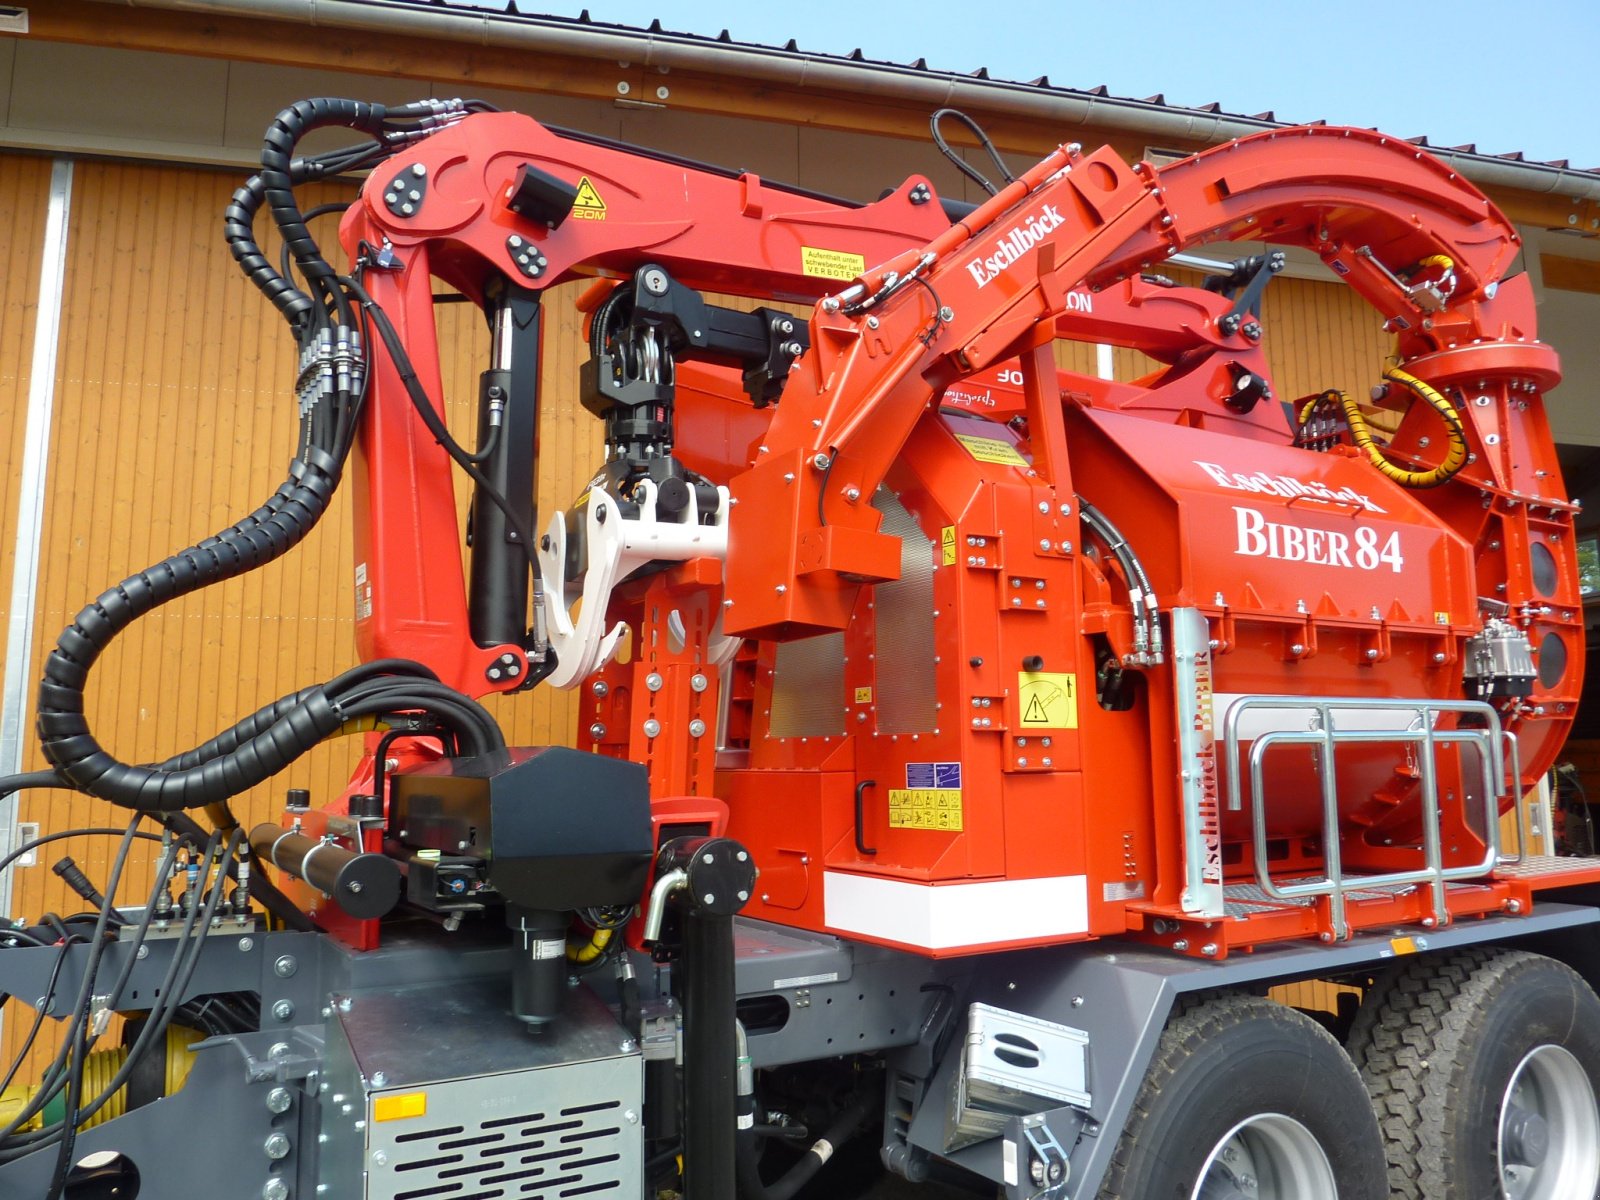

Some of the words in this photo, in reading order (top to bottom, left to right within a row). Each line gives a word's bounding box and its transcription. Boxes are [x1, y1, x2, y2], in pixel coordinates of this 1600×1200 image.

[965, 204, 1066, 289] Eschlböck
[1066, 291, 1093, 313] ON
[1195, 742, 1220, 885] Eschlböck
